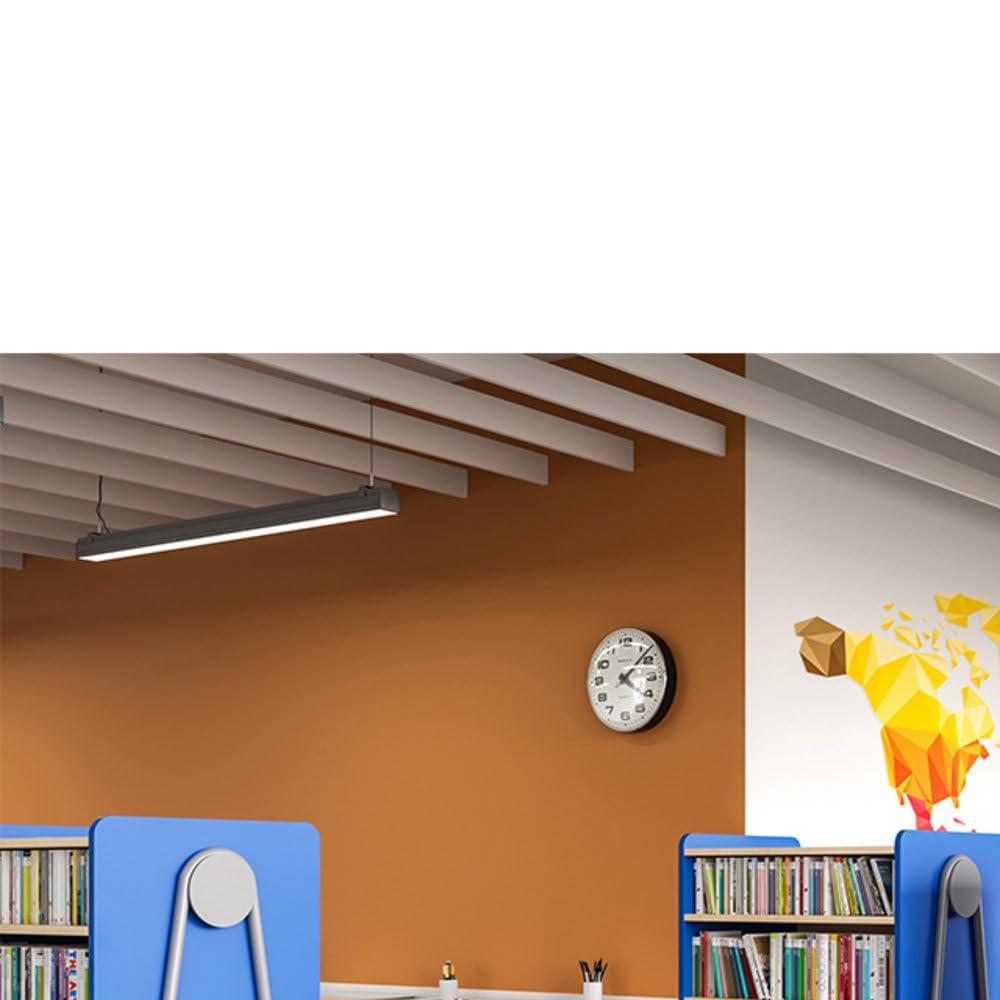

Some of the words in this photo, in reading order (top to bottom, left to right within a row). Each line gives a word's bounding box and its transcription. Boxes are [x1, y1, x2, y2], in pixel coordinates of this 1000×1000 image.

[618, 637, 633, 647] 12
[597, 659, 610, 670] 10
[643, 655, 654, 665] 2
[594, 676, 604, 686] 9
[647, 672, 657, 682] 3
[598, 693, 607, 703] 8
[605, 705, 614, 715] 7
[620, 711, 631, 721] 6
[68, 950, 78, 976] THE
